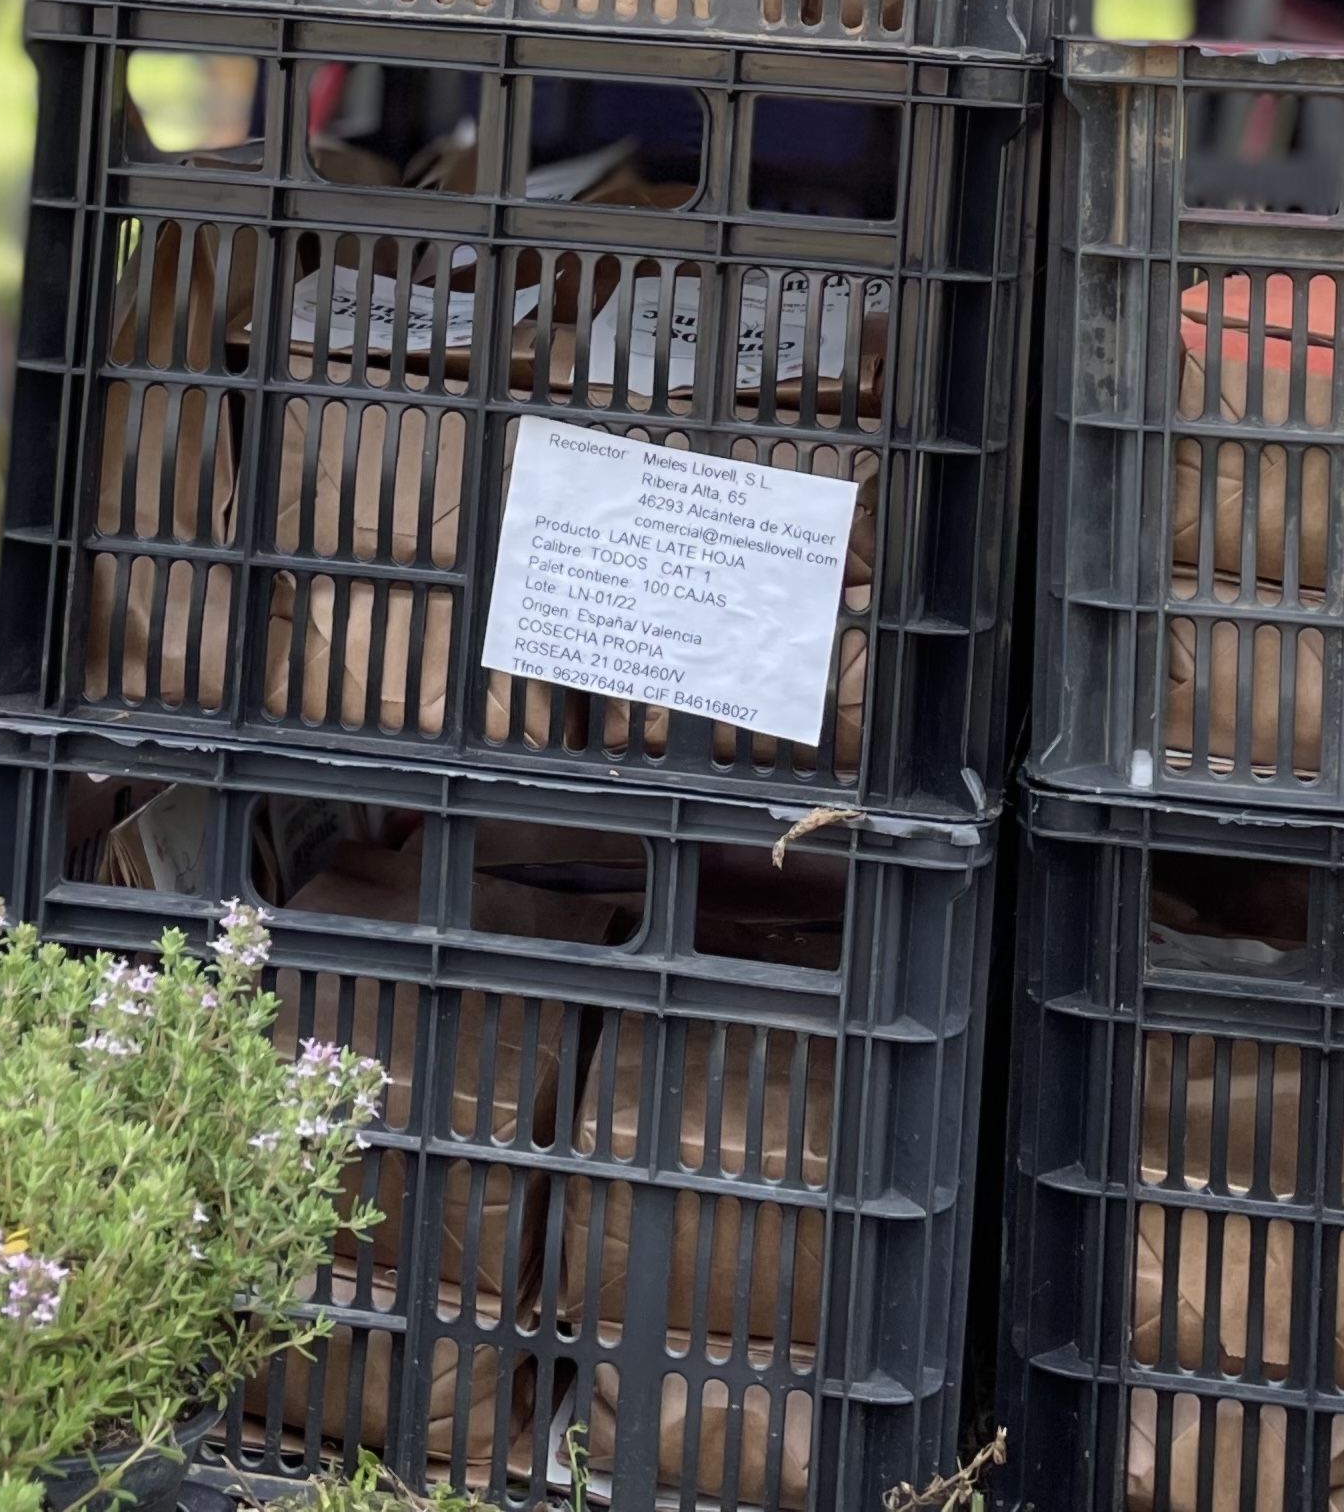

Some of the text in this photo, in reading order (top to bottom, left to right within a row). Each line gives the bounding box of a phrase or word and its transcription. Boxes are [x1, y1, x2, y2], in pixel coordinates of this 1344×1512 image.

[643, 452, 687, 472] Mieles
[691, 460, 740, 485] Llovell,
[642, 473, 746, 505] Ribera Alta, 65
[638, 494, 836, 546] 46293 Alcántera de Xúquer
[591, 548, 647, 570] TODOS
[704, 571, 710, 583] 1
[609, 530, 651, 550] LANE
[655, 539, 697, 560] LATE
[701, 549, 746, 568] HOJA
[528, 556, 565, 577] Palet
[643, 580, 670, 597] 100
[673, 585, 728, 608] CAJAS
[569, 585, 636, 611] LN-01/22
[519, 618, 663, 658] COSECHA PROPIA
[641, 620, 703, 646] Valencia
[552, 666, 634, 696] 962976494
[643, 686, 670, 702] CIF
[674, 691, 759, 721] B46168027
